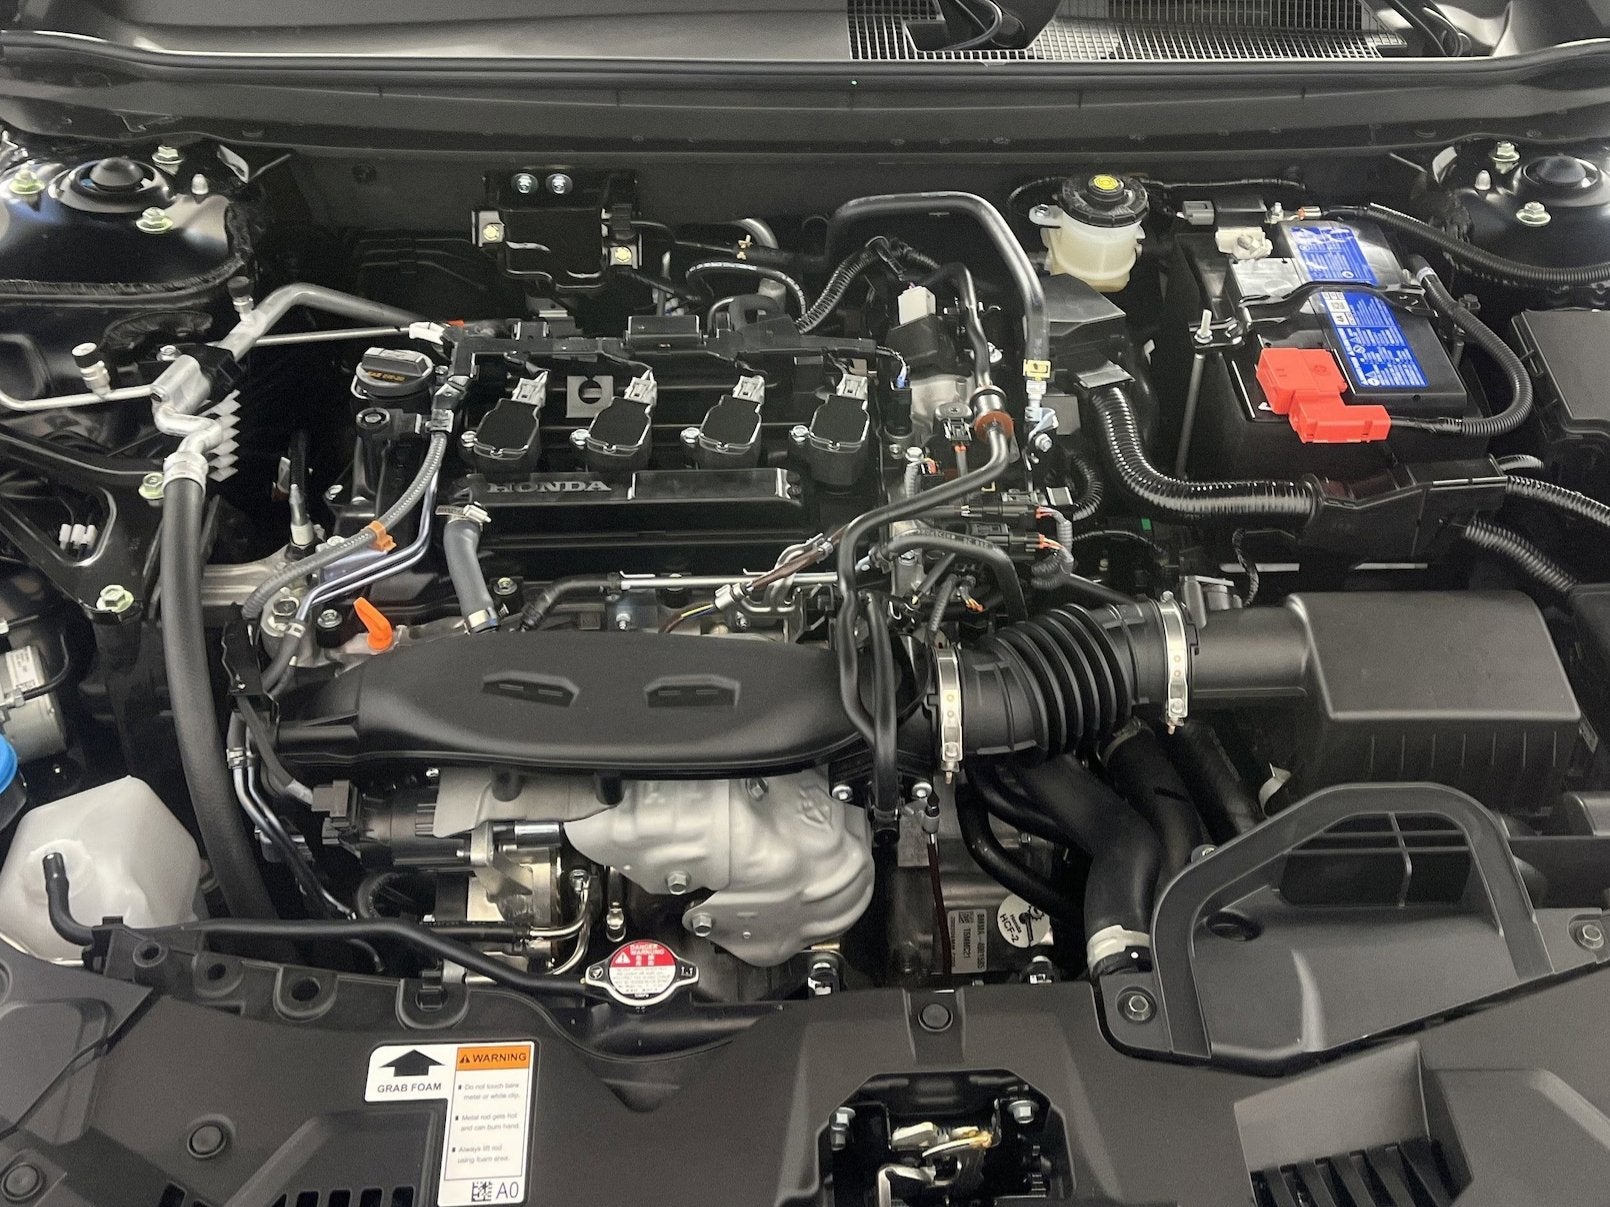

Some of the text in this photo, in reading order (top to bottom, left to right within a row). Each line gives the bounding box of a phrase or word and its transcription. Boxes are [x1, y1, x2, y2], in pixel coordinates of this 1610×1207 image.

[487, 480, 612, 493] HONDA
[1000, 913, 1020, 943] HCF-2
[472, 1052, 527, 1063] WARNING
[377, 1082, 442, 1093] GRAB FOAM
[460, 1124, 473, 1132] and
[458, 1145, 481, 1153] Always
[495, 1181, 519, 1200] A0
